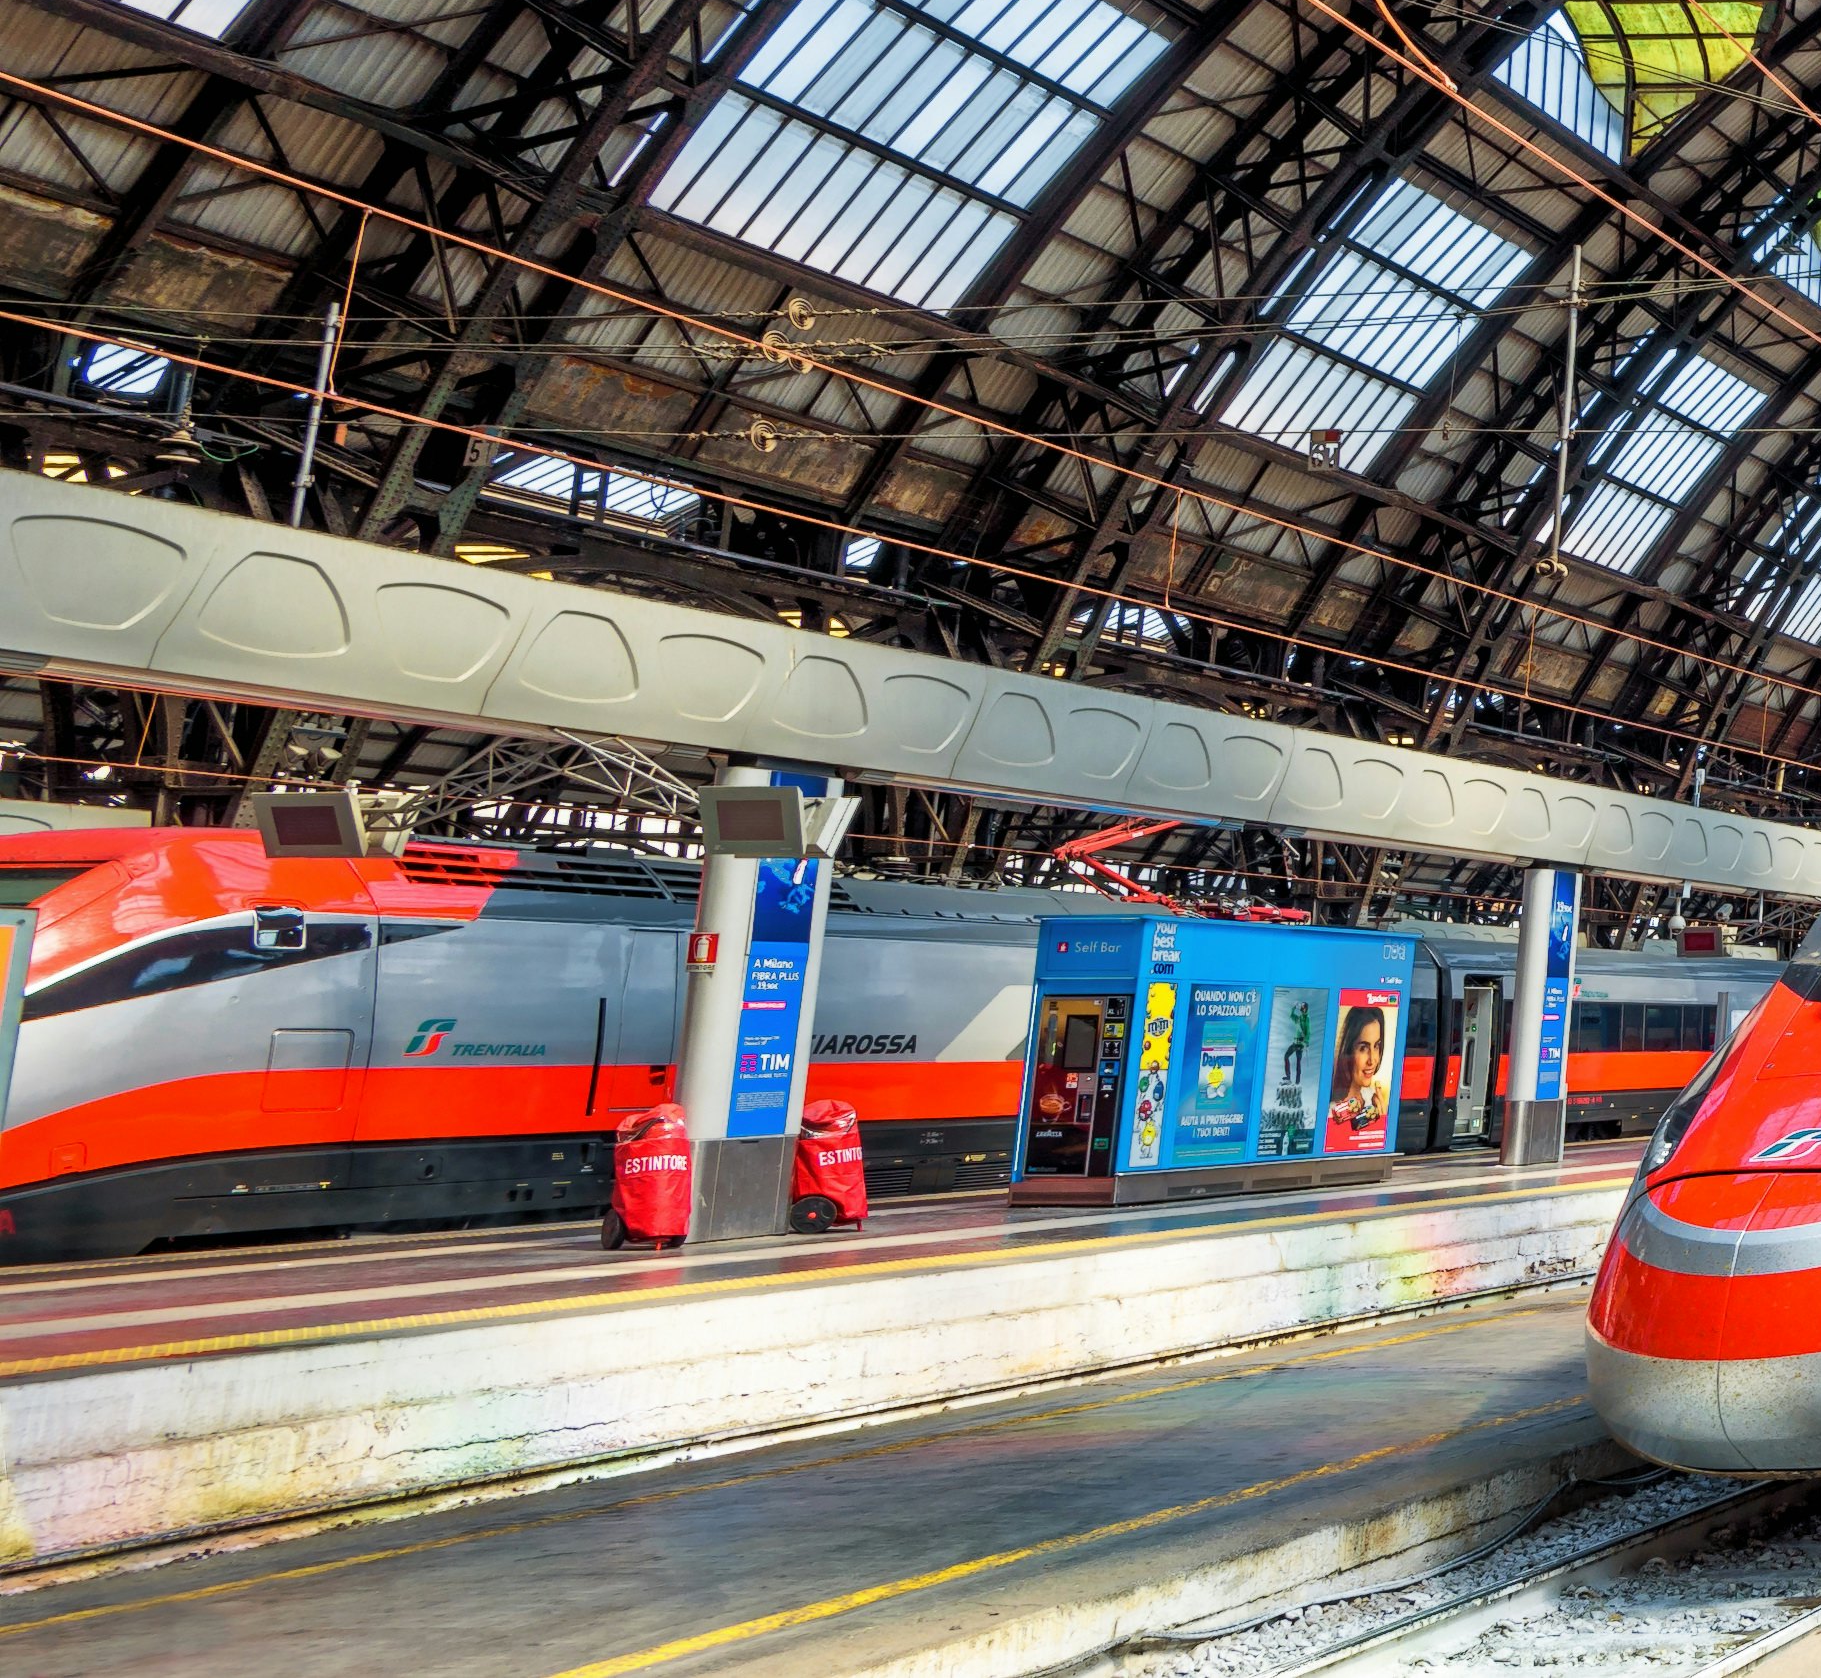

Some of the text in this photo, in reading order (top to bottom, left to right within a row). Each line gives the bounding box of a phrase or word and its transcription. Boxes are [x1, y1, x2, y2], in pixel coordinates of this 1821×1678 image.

[1155, 922, 1178, 935] your
[1074, 941, 1122, 953] Self Bar
[1153, 933, 1175, 949] best
[1151, 947, 1182, 962] break
[753, 958, 794, 969] A Milano
[1150, 962, 1175, 974] .com
[751, 971, 800, 981] FIBRA PLUS
[1195, 990, 1227, 1002] QUANDO
[1228, 991, 1245, 1002] NON
[1196, 1004, 1251, 1017] LO SPAZZOLINO
[452, 1043, 546, 1057] TRENITALIA
[811, 1034, 917, 1055] IAROSSA
[760, 1053, 790, 1071] TIM
[624, 1154, 688, 1175] ESTINTORE
